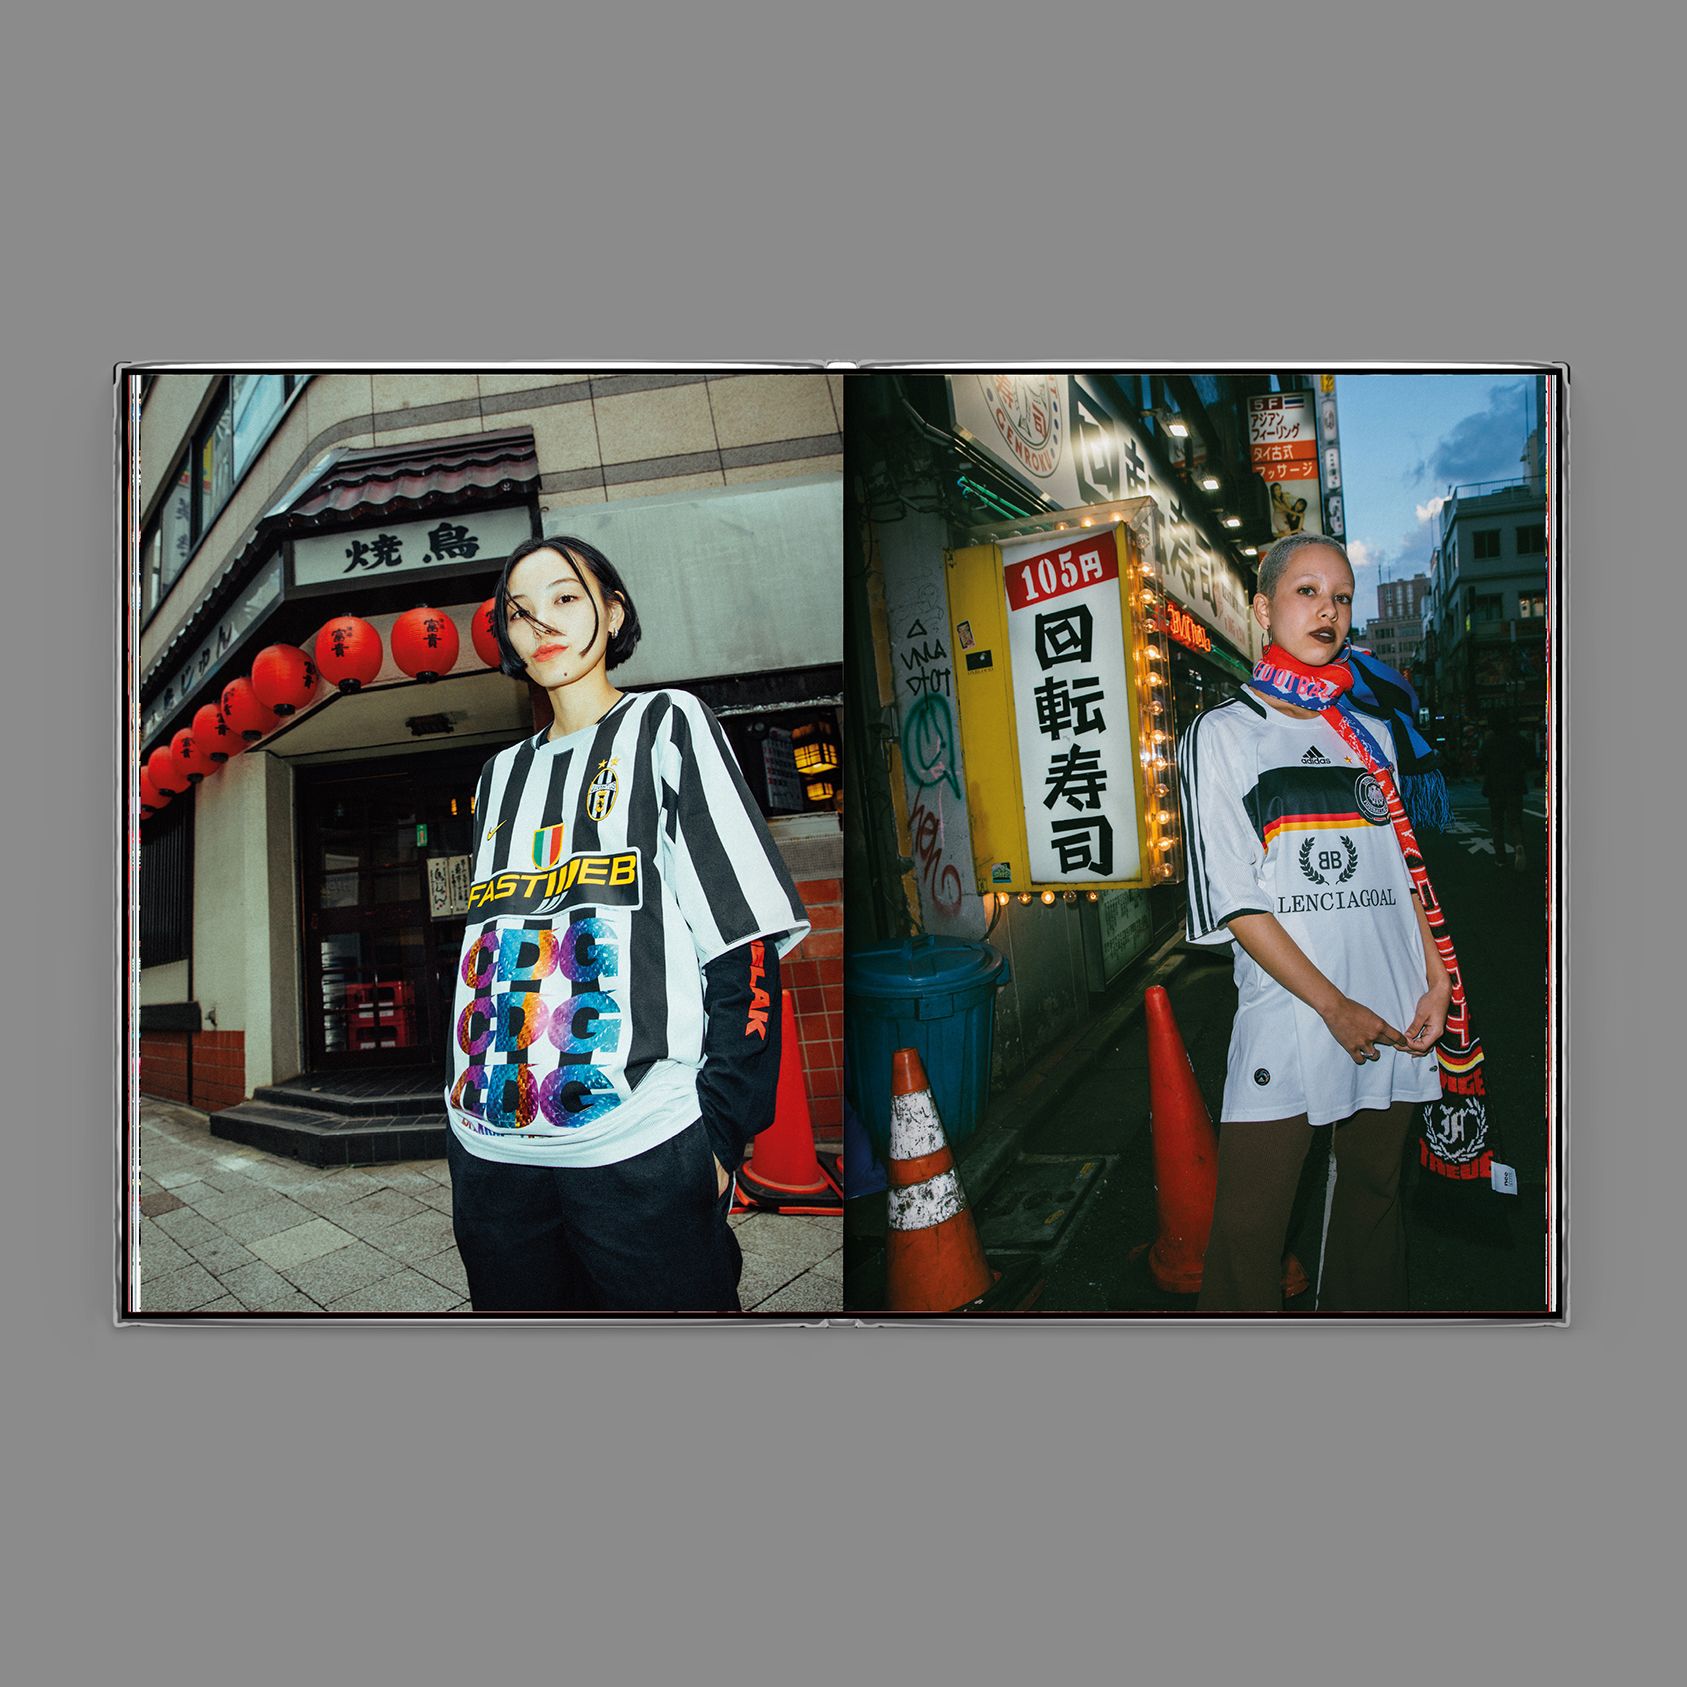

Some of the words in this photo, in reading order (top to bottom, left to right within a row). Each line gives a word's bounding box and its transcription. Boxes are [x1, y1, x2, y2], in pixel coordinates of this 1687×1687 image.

[996, 408, 1052, 472] GENROKU
[1251, 412, 1284, 428] アジアン
[1251, 423, 1300, 442] フィーリング
[1254, 444, 1294, 462] タイ古式
[1256, 462, 1314, 479] マッサージ
[342, 521, 480, 574] 焼鳥
[1021, 550, 1103, 601] 105円
[1034, 603, 1113, 877] 回転寿司
[1301, 755, 1331, 765] adidas
[467, 855, 637, 909] FASTWEB
[1278, 889, 1396, 913] LENCIAGOAL
[461, 917, 619, 989] CDG
[457, 990, 622, 1056] CDG
[450, 1063, 621, 1129] CDG
